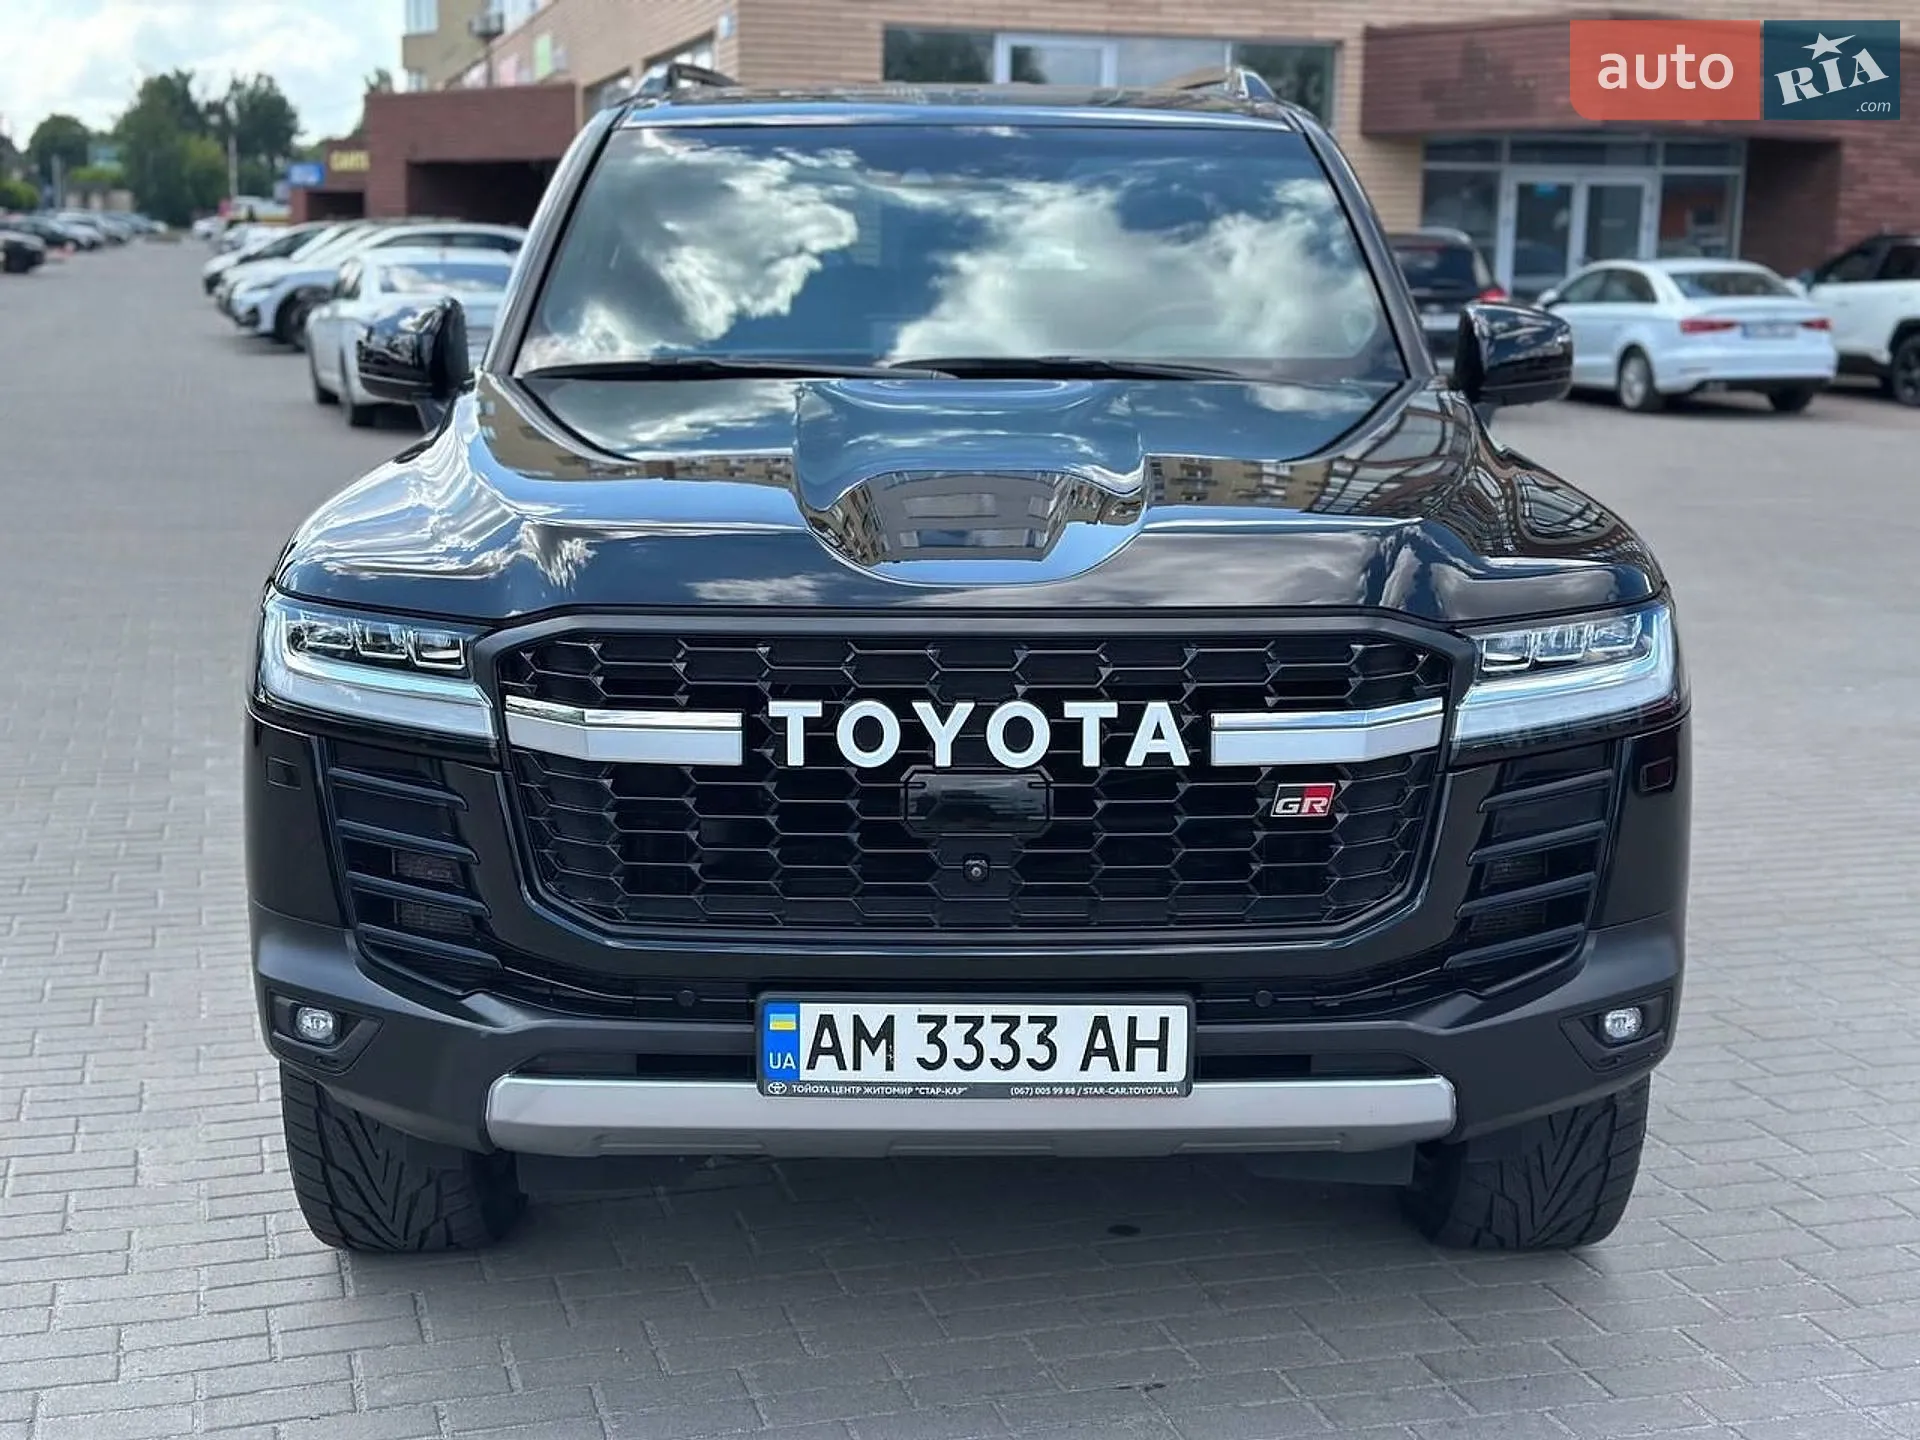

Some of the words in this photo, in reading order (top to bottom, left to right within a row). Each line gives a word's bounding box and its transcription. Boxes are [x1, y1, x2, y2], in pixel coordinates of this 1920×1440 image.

[768, 700, 1190, 769] TOYOTA
[1275, 797, 1329, 815] GR
[806, 1013, 895, 1072] AM
[916, 1014, 1058, 1072] 3333
[1079, 1015, 1170, 1073] AH
[769, 1052, 796, 1070] UA
[791, 1083, 831, 1095] ТОЙОТА
[831, 1085, 863, 1096] ЦЕНТР
[863, 1085, 913, 1096] ЖИТОМИР
